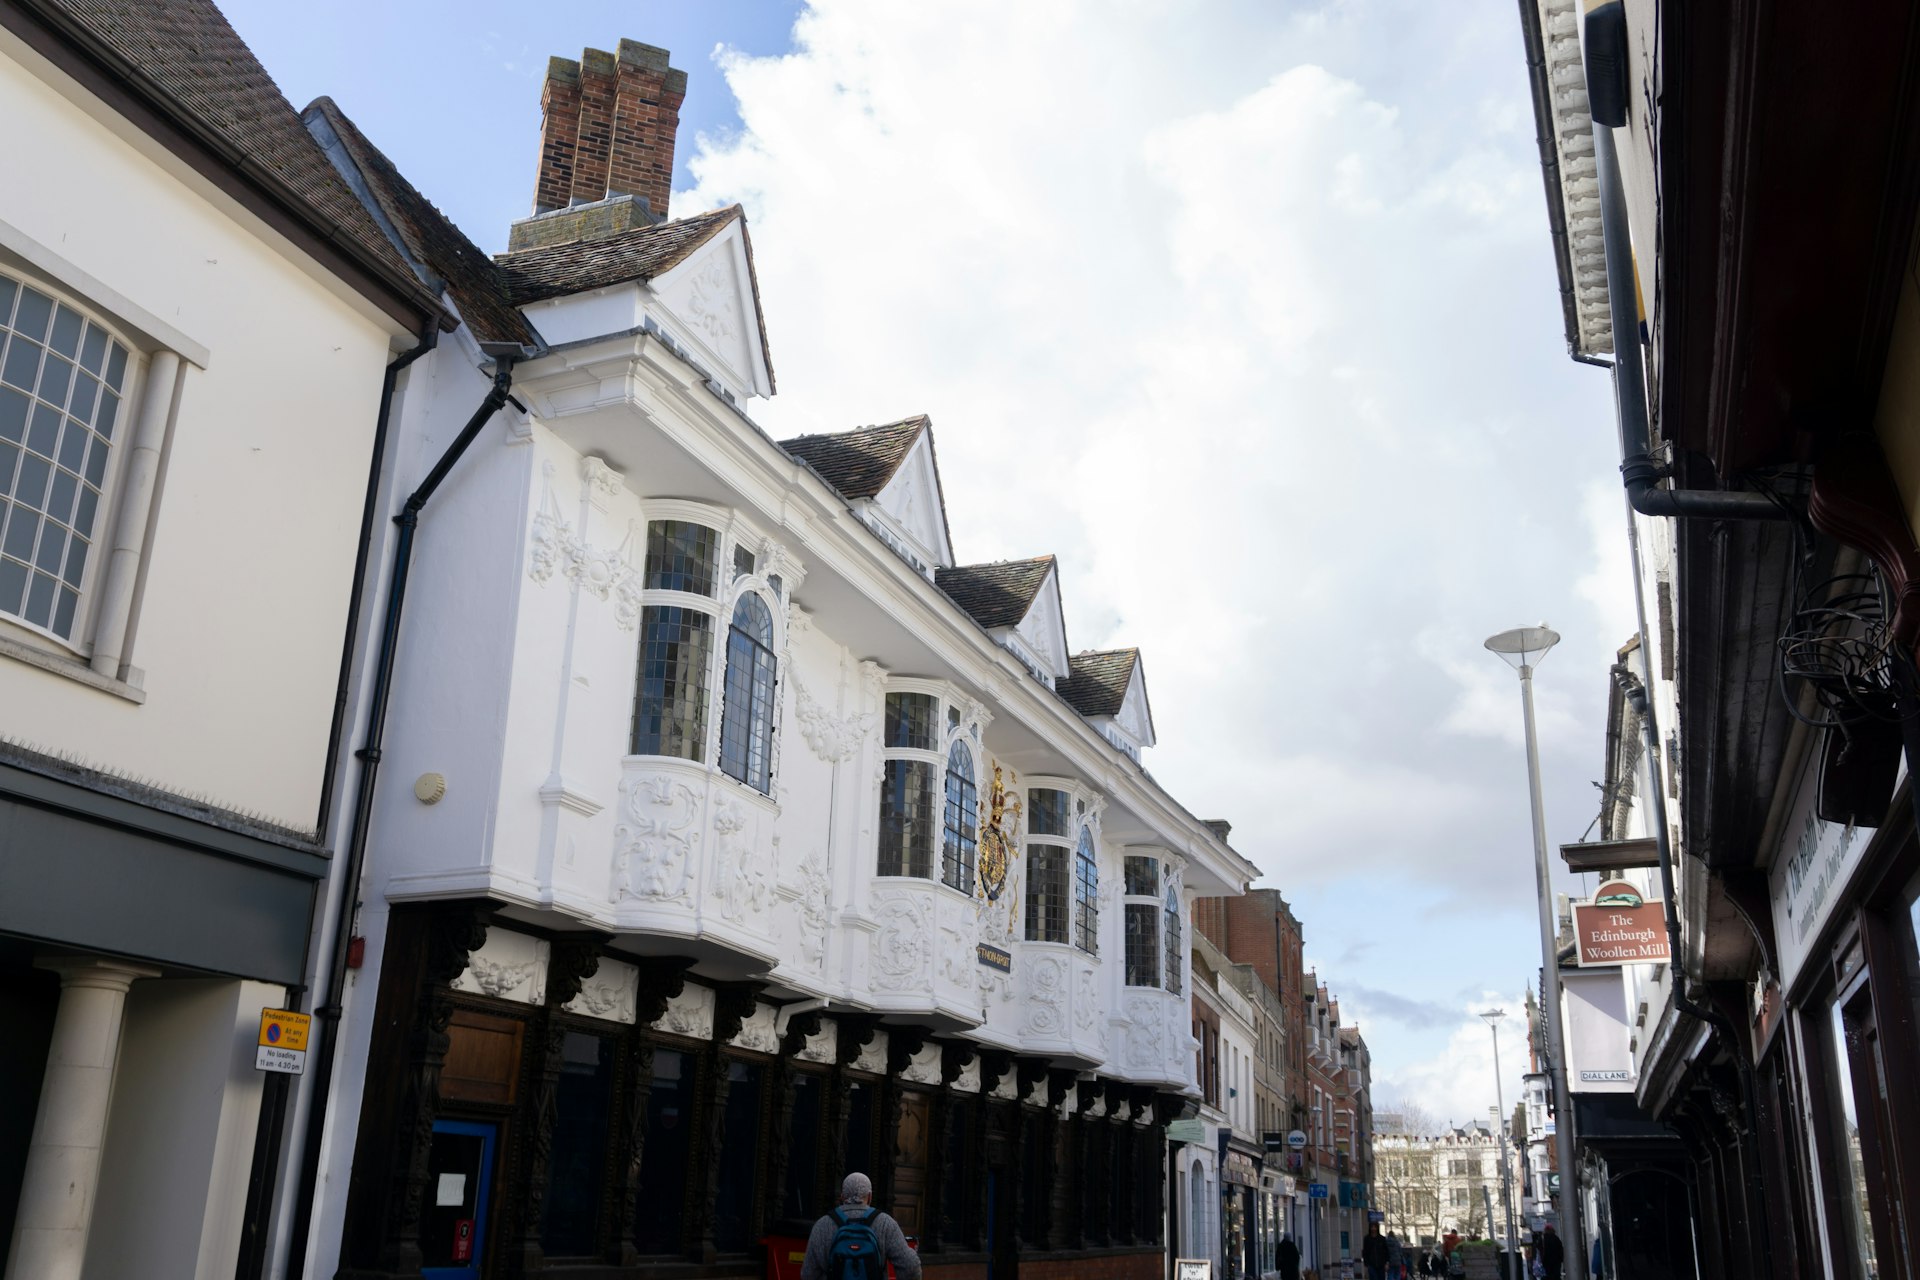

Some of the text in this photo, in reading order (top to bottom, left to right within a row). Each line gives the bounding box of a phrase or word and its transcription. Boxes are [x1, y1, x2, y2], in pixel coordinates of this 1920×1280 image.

[1609, 914, 1633, 926] The
[1591, 928, 1656, 943] Edinburgh
[1587, 943, 1665, 959] Woollen Mill
[265, 1011, 308, 1024] Pedestrian Zone
[267, 1049, 296, 1061] No loading
[277, 1061, 292, 1070] 4.30
